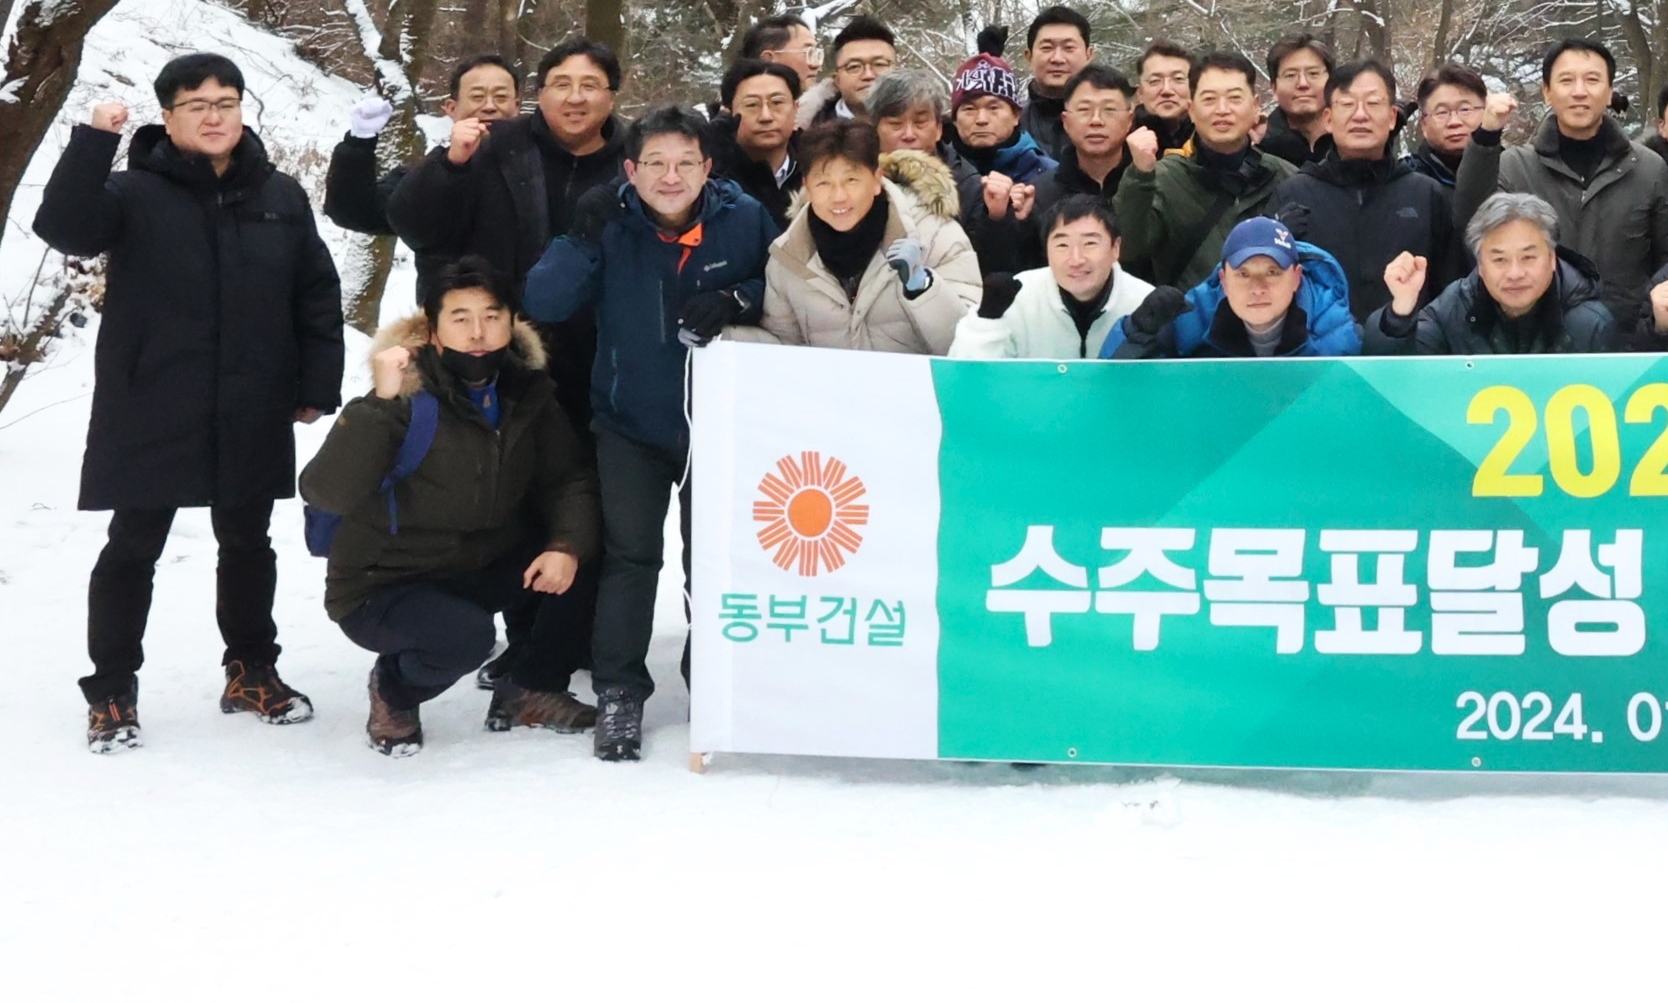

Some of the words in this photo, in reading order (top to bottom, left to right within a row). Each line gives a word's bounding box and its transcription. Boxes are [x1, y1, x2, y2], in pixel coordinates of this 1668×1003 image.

[985, 524, 1646, 656] 수주목표달성
[718, 593, 907, 647] 동부건설
[1455, 691, 1603, 743] 2024.
